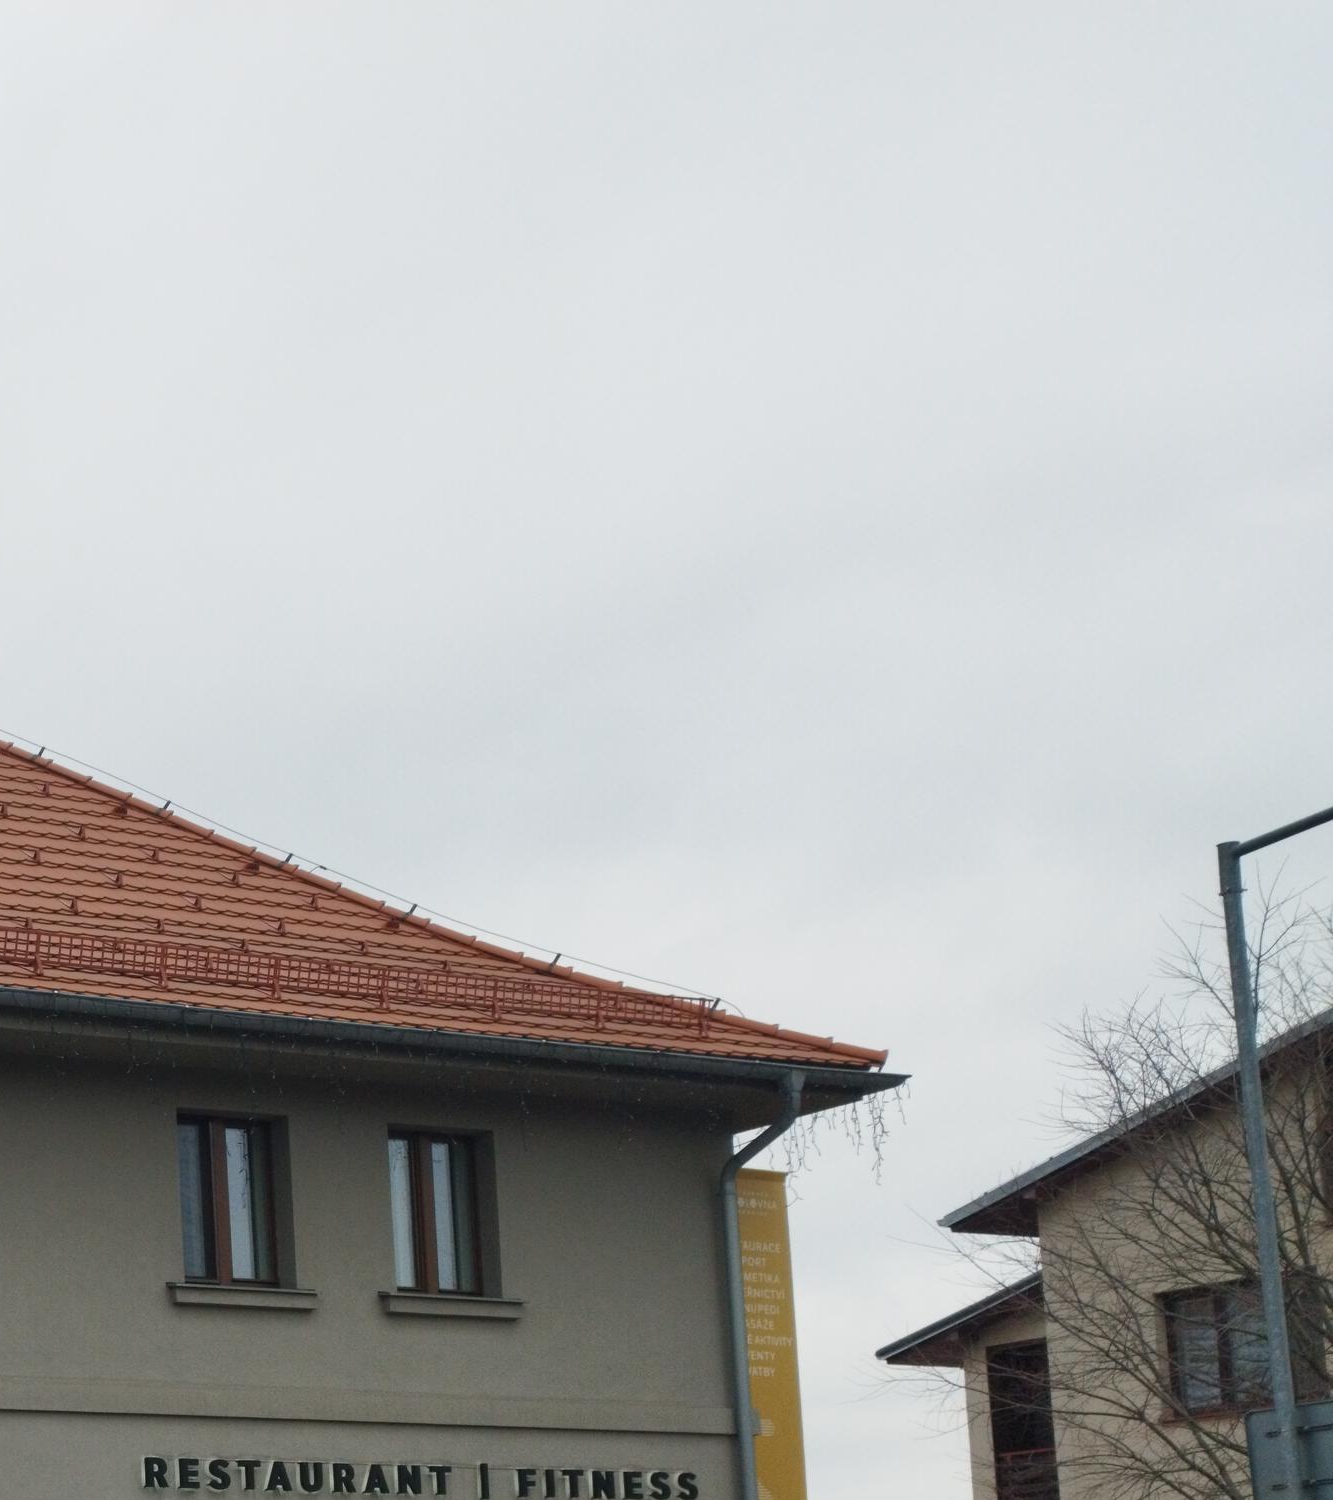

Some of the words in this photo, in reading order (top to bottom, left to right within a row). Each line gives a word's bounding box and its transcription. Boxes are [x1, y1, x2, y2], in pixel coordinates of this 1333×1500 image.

[742, 1240, 782, 1254] AURACE
[741, 1256, 766, 1268] PORT
[743, 1271, 781, 1284] METIKA
[142, 1456, 453, 1497] RESTAURANT
